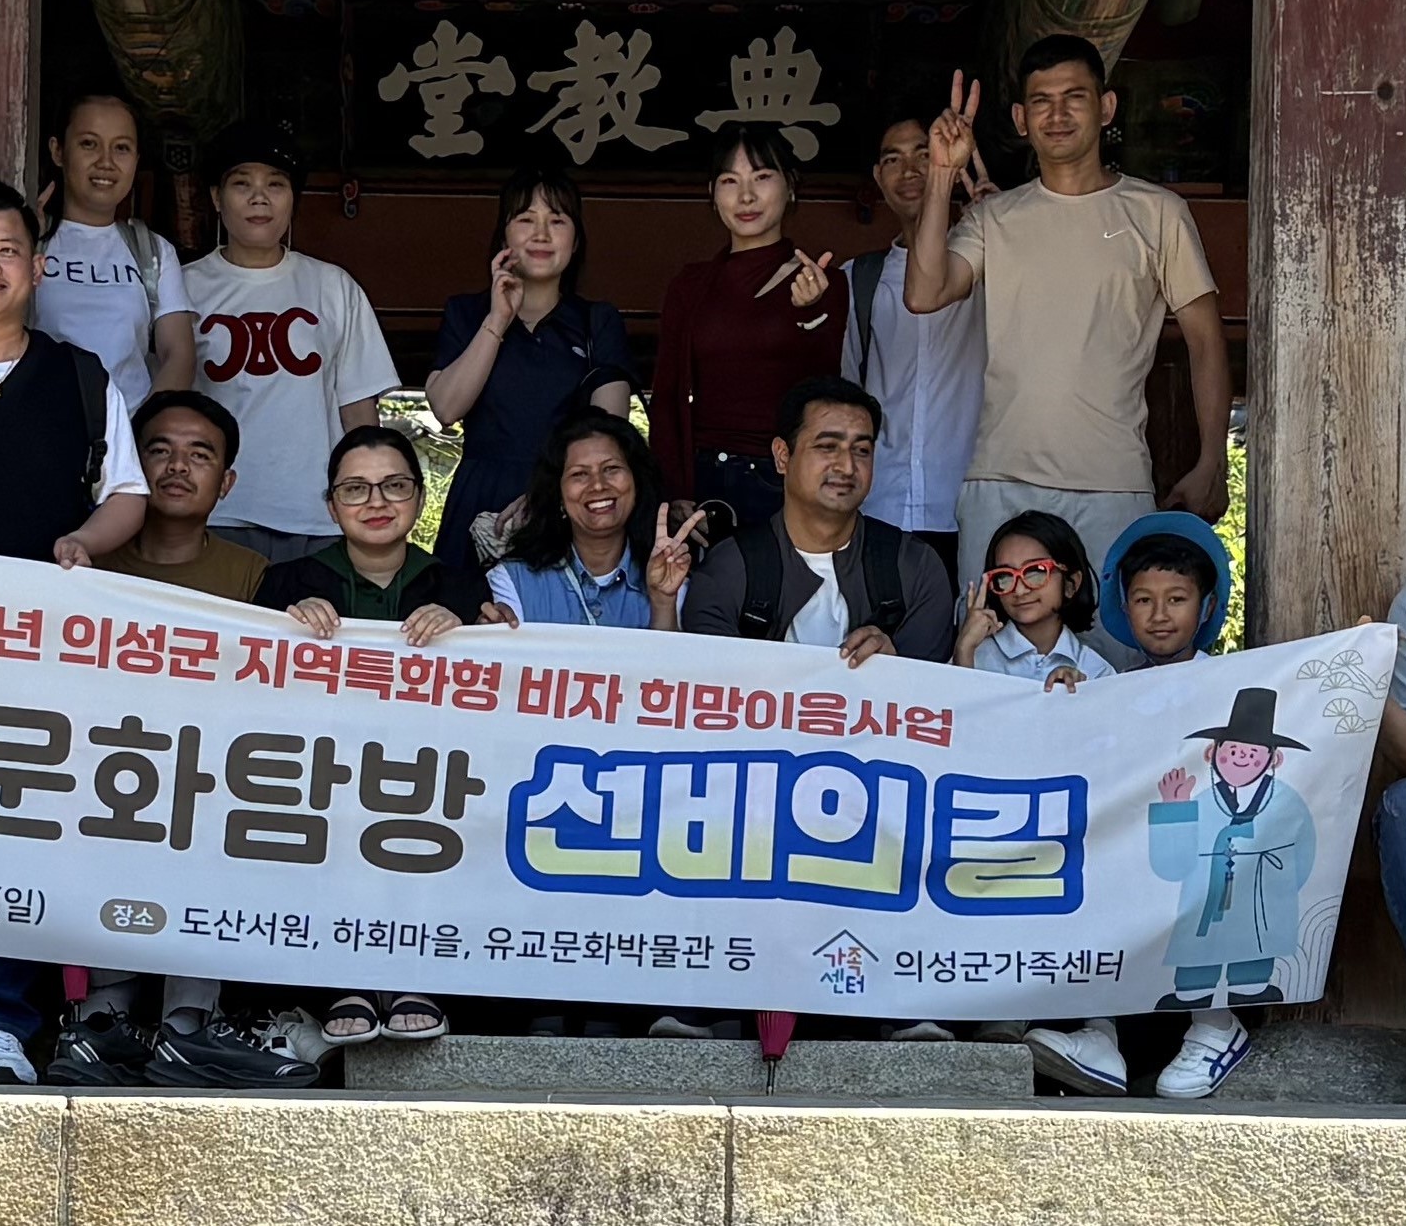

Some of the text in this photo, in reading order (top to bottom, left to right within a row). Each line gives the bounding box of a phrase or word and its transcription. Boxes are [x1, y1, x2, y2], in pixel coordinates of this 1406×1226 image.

[59, 614, 220, 682] 의성군
[235, 636, 503, 712] 지역특화형
[517, 665, 624, 724] 비자
[637, 678, 953, 748] 희망이음사업
[522, 757, 911, 899] 선비의
[942, 785, 1075, 902] 길
[112, 904, 756, 972] 장소 도산서원, 하회마을, 유교문화박물관 등
[823, 946, 863, 977] 가족
[820, 968, 865, 994] 센터
[893, 948, 1124, 984] 의성군가족센터
